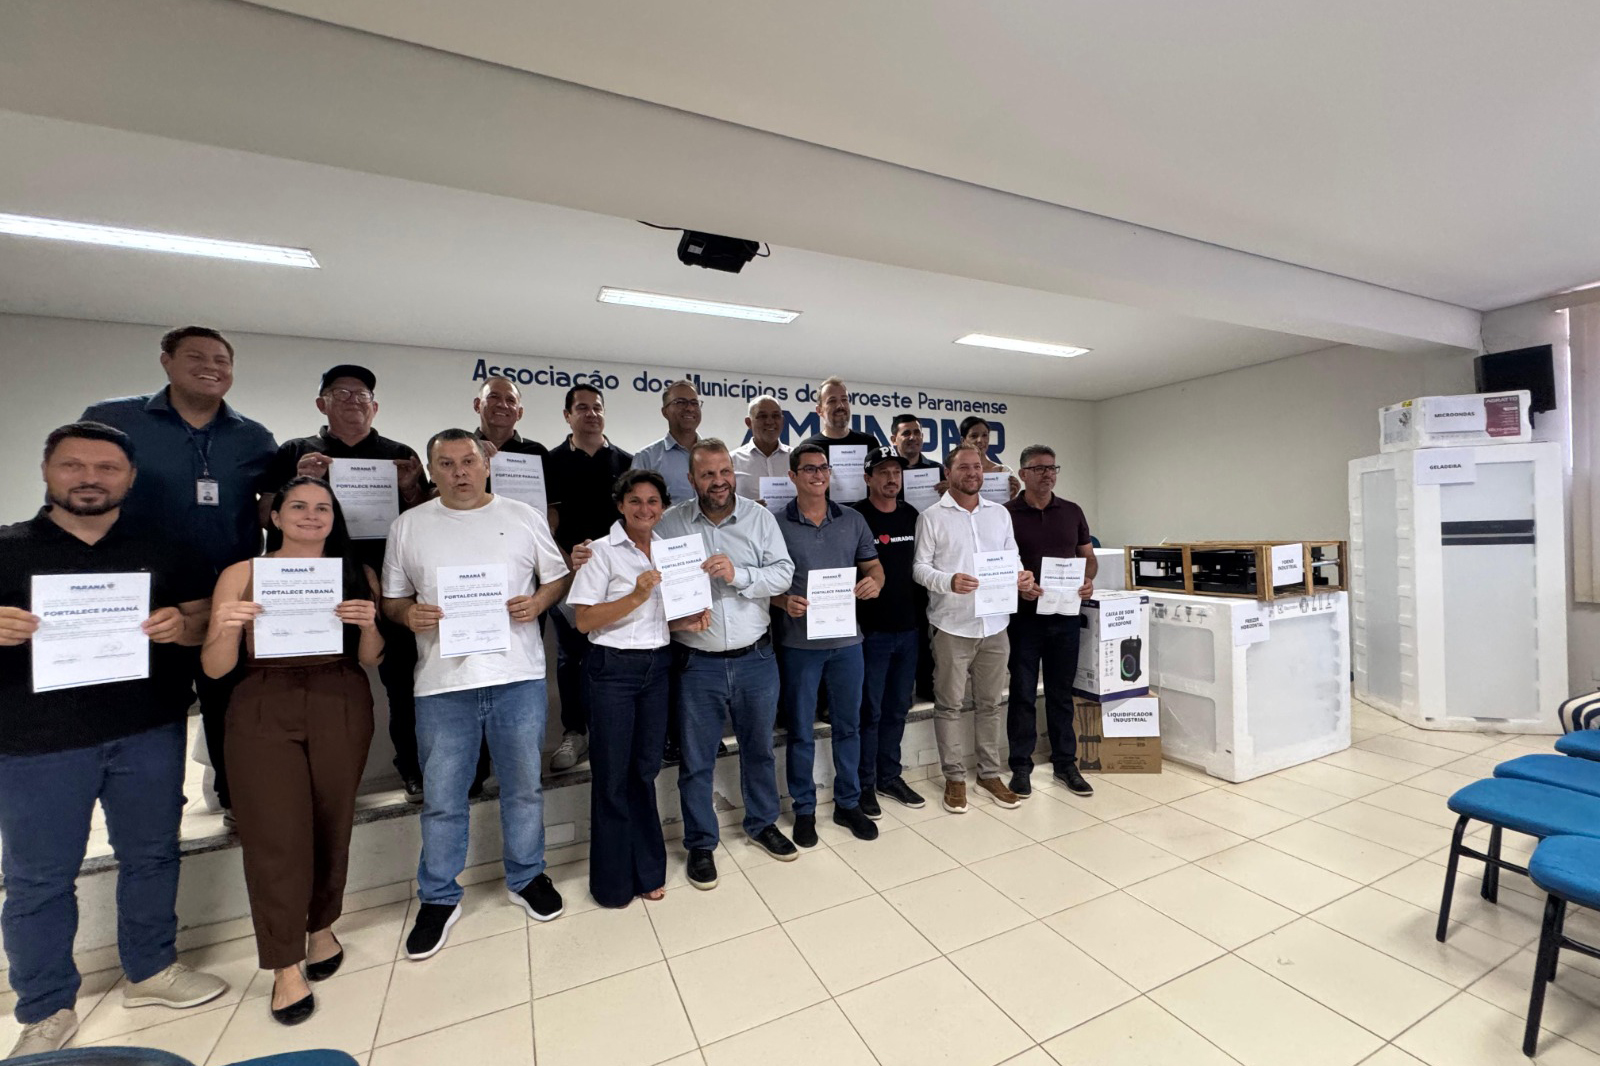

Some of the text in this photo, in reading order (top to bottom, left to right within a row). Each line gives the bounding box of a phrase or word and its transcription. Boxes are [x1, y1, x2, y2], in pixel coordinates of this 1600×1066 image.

[918, 392, 1008, 414] Paranaense
[44, 605, 140, 617] FORTALECE PARANÁ
[1107, 620, 1132, 628] MICROFONE
